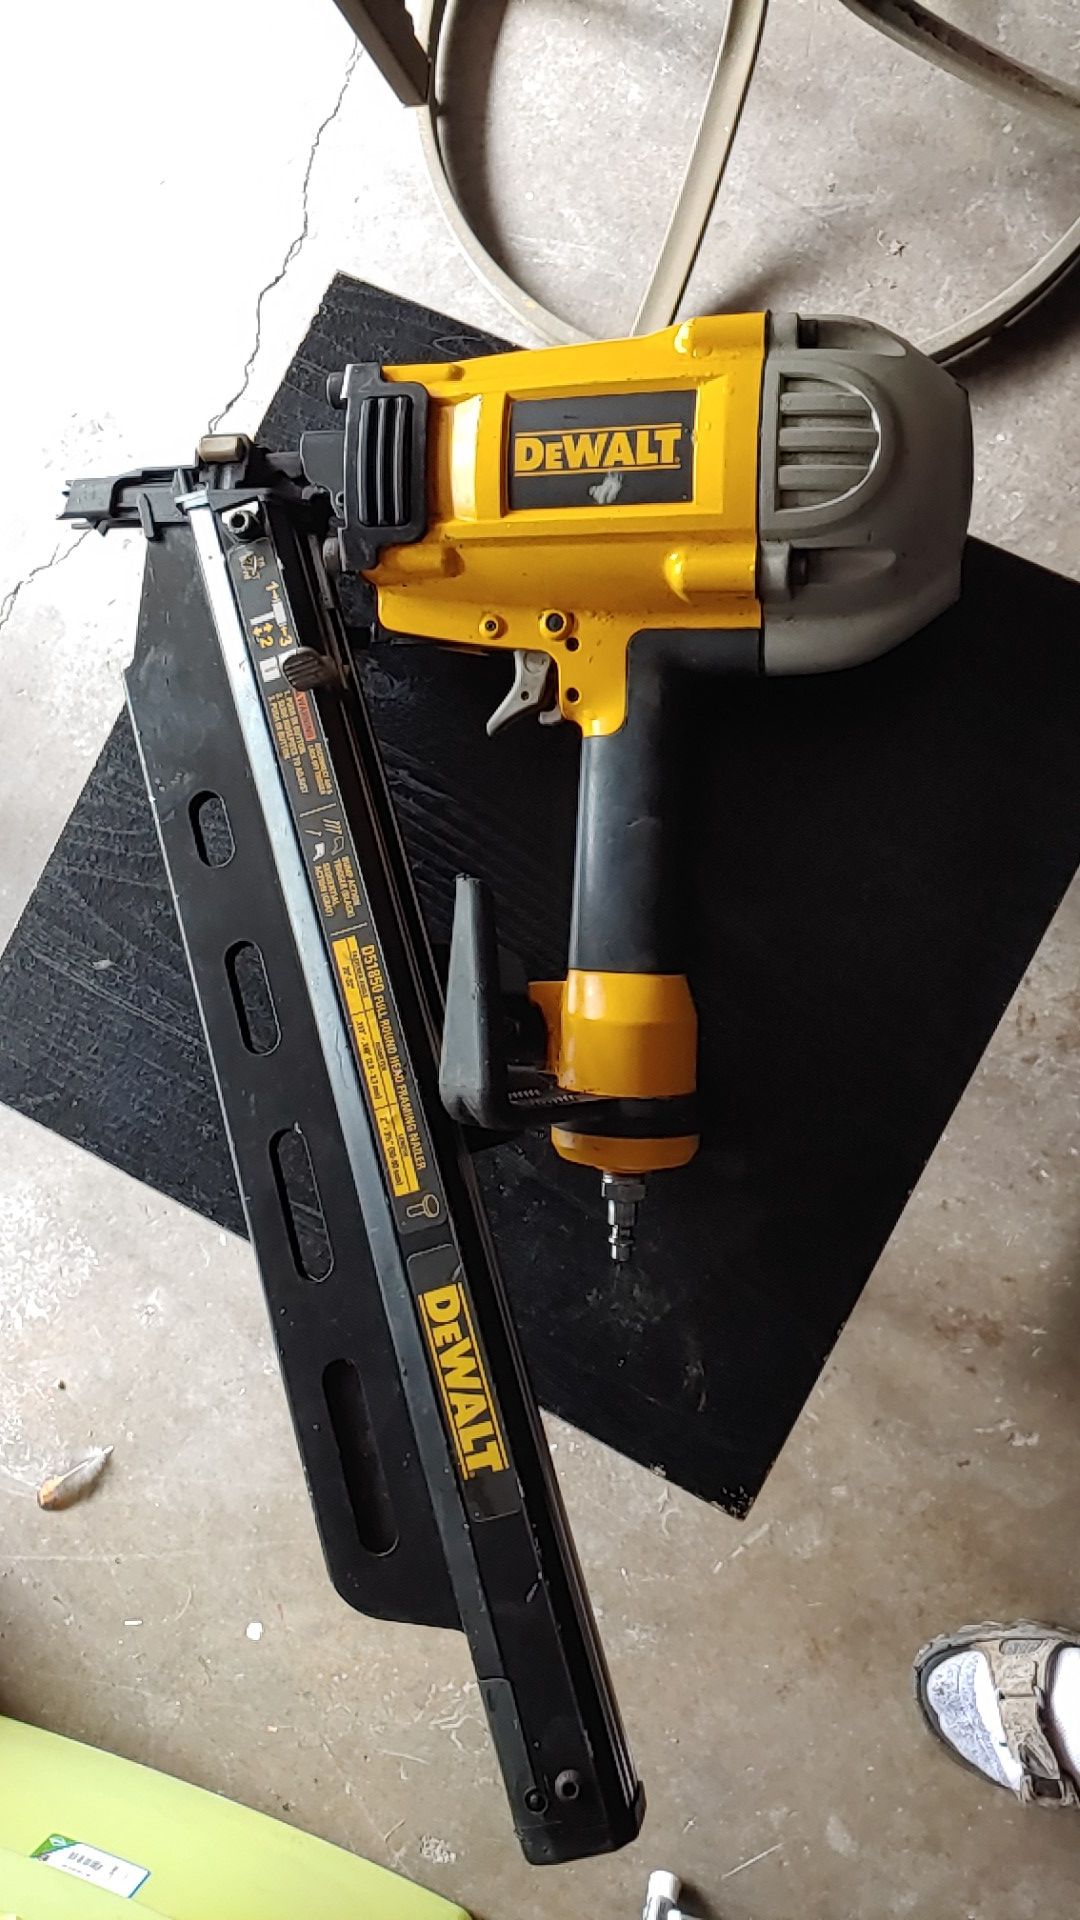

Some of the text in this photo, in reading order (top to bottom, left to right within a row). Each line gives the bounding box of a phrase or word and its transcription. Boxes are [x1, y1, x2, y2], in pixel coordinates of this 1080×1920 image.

[258, 635, 274, 649] 2
[297, 694, 313, 740] WARNING
[314, 865, 327, 892] ACTION
[347, 878, 360, 906] ACTION
[361, 944, 426, 1170] D51850 FULL ROUND HEAD FRAMING NAILER
